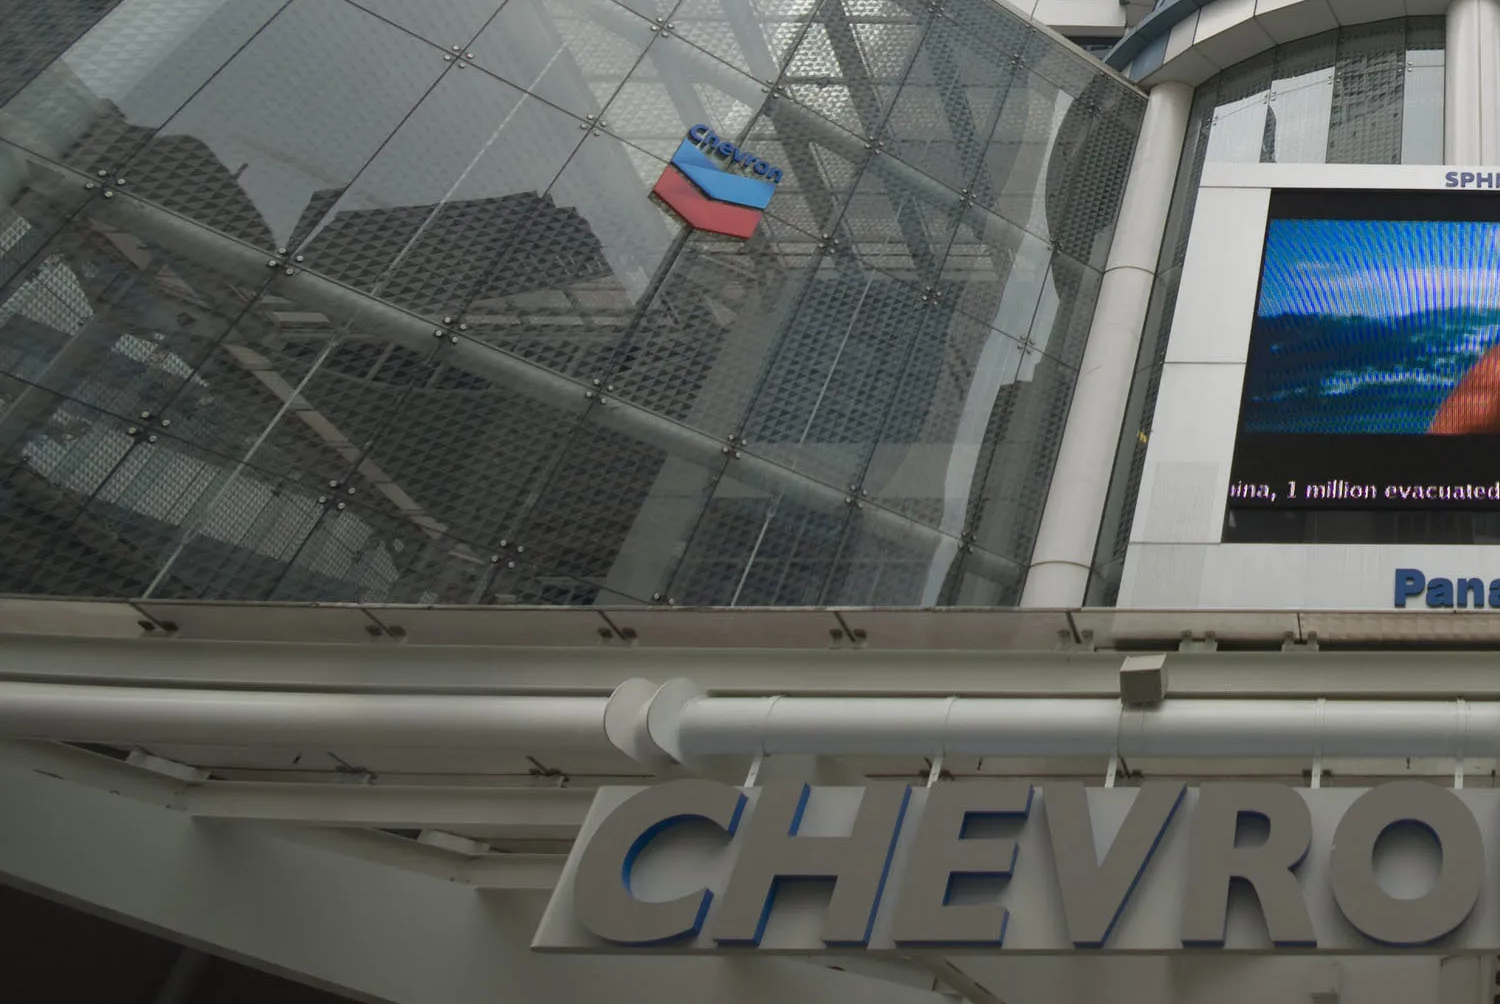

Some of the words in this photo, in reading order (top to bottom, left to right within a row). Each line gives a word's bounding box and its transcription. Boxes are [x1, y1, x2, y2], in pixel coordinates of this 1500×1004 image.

[687, 123, 783, 184] Chevron
[1287, 481, 1297, 498] 1
[1306, 479, 1377, 499] million
[1385, 481, 1500, 500] evacuated
